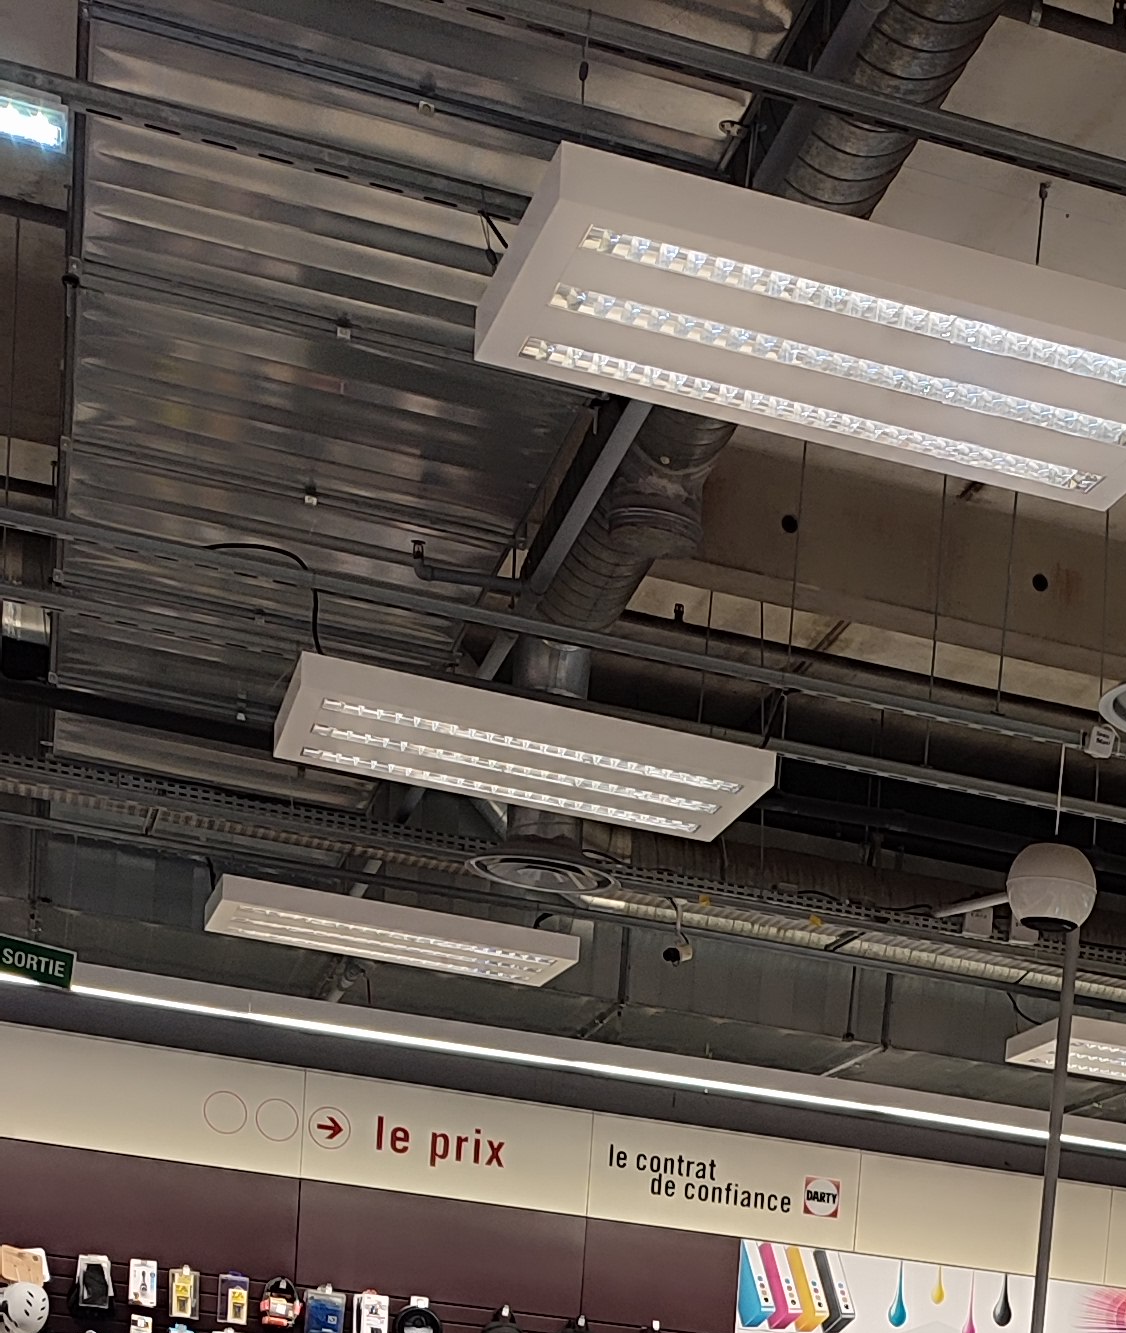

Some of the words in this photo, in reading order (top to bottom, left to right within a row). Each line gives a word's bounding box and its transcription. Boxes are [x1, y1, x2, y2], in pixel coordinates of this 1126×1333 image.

[1, 947, 66, 978] SORTIE
[375, 1115, 411, 1154] le
[429, 1128, 506, 1168] prix
[608, 1143, 628, 1168] le
[636, 1151, 717, 1181] contrat
[649, 1173, 676, 1198] de
[683, 1181, 792, 1214] confiance
[805, 1189, 839, 1205] DARTY
